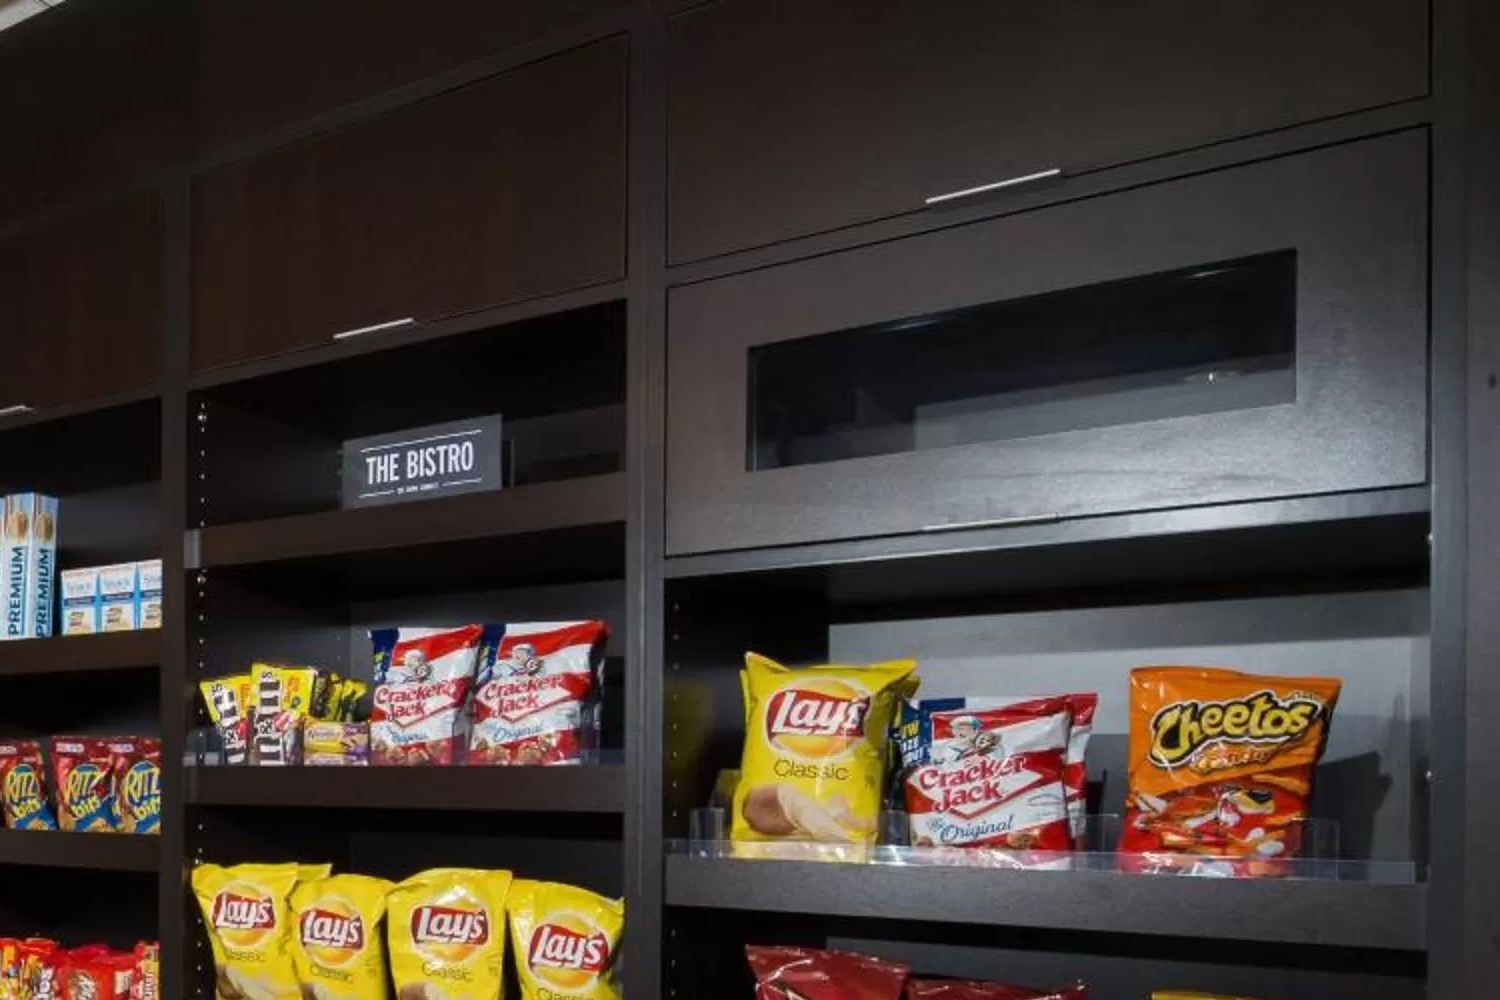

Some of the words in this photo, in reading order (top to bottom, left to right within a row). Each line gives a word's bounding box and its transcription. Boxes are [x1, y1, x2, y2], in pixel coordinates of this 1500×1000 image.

[366, 453, 400, 484] THE
[407, 441, 474, 478] BISTRO
[8, 546, 25, 636] PREMIUM
[35, 547, 51, 637] PREMIUM
[484, 675, 564, 702] Cracker
[490, 695, 539, 717] Jack
[1151, 691, 1318, 763] Cheetos
[919, 757, 1028, 791] Cracker
[932, 779, 1003, 813] Jack
[939, 803, 1016, 843] Original
